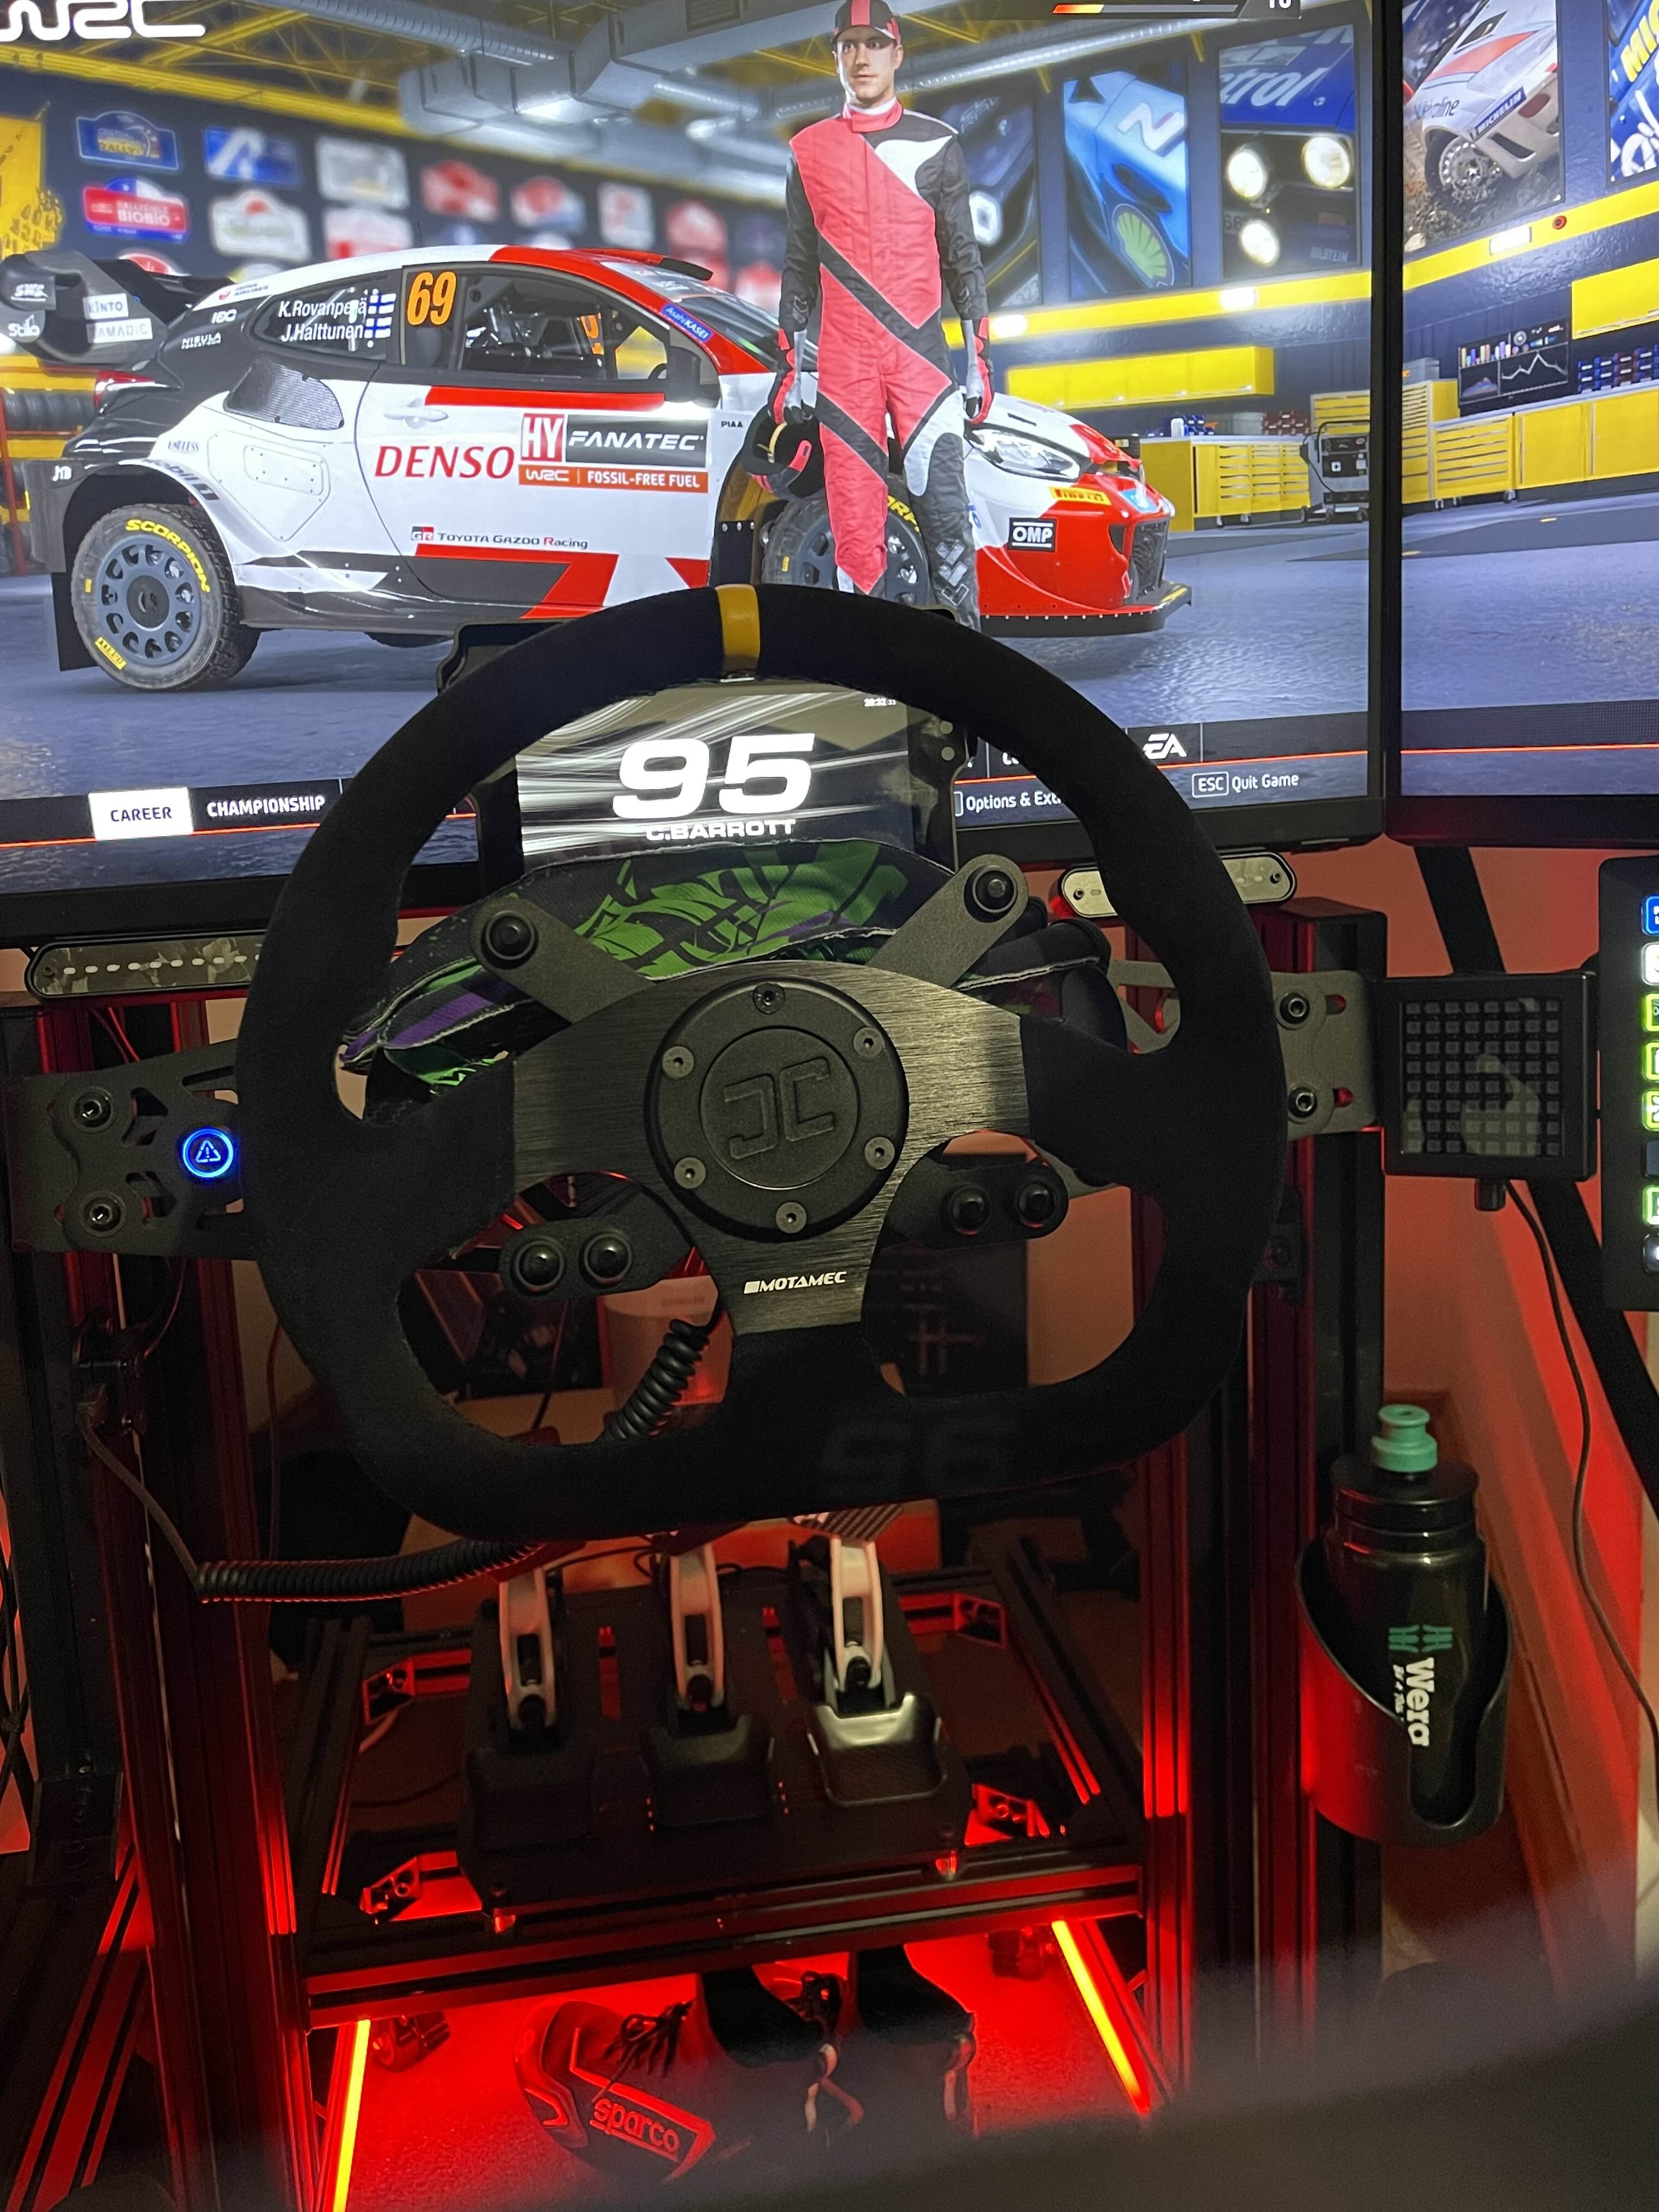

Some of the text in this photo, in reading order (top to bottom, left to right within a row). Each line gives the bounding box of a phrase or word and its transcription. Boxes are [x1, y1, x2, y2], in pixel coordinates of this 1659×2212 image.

[407, 271, 457, 325] 69
[568, 430, 699, 452] FANATEC
[375, 445, 515, 478] DENSO
[525, 469, 701, 488] WRC FOSSIL-FREE FUEL
[411, 531, 588, 550] GR TOYOTA GAZOO Racing
[1013, 527, 1053, 543] OMP
[125, 518, 211, 593] SCORPION
[1143, 732, 1187, 760] EA
[612, 732, 816, 820] 95
[1198, 774, 1300, 792] ESC Quit Game
[110, 806, 173, 822] CAREER
[206, 794, 326, 818] CHAMPIONSHIP
[966, 791, 1062, 814] Options & Ext
[645, 819, 796, 841] C.BARROTT
[759, 1271, 847, 1292] MOTAMEC
[1406, 1657, 1435, 1747] Wera
[594, 2097, 681, 2154] sparco
